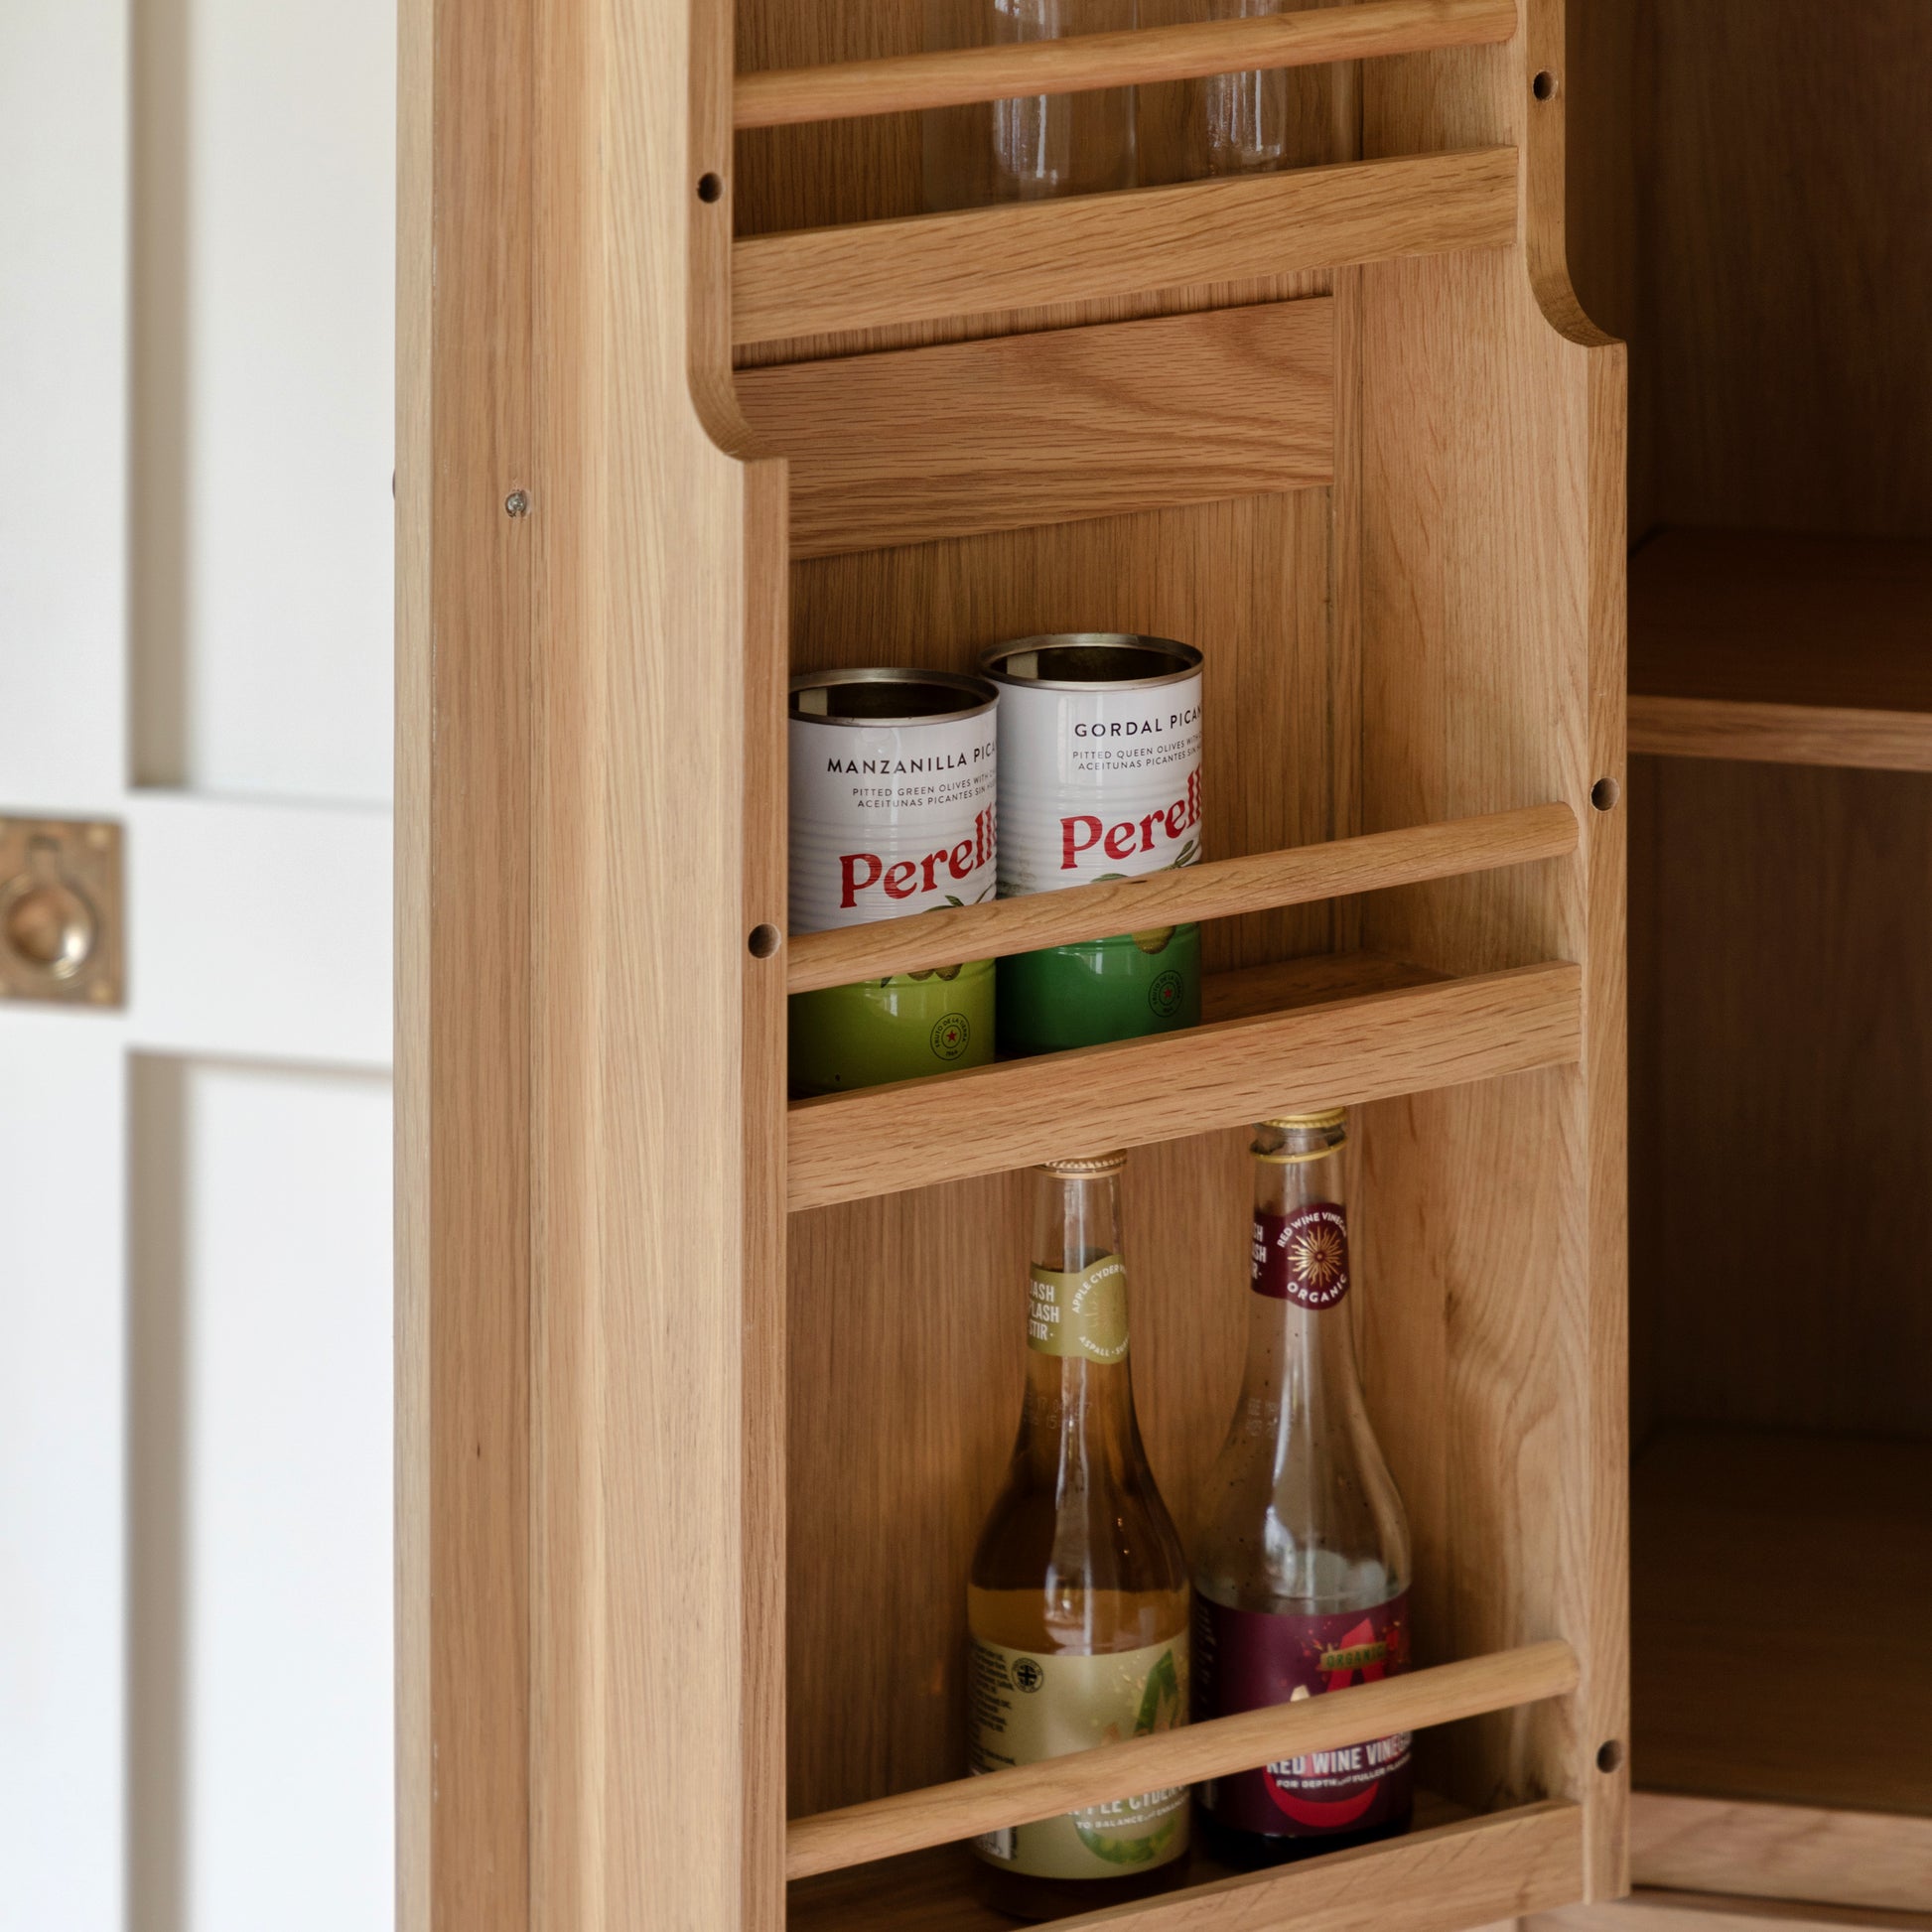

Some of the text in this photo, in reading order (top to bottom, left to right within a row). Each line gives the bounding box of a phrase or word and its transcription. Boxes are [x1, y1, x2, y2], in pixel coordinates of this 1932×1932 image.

[1074, 719, 1163, 738] GORDAL
[1072, 751, 1112, 759] PITTED
[1116, 748, 1153, 759] QUEEN
[1157, 739, 1184, 755] OLIVES
[826, 752, 968, 775] MANZANILLA
[1077, 759, 1142, 770] ACEITUNAS
[1146, 751, 1185, 766] PICANTES
[852, 787, 893, 797] PITTED
[897, 785, 934, 796] GREEN
[938, 778, 971, 793] OLIVES
[857, 798, 923, 808] ACEITUNAS
[927, 790, 973, 805] PICANTES
[839, 800, 997, 909] Perell
[1277, 1227, 1294, 1248] RED
[1291, 1212, 1320, 1230] WINE
[1071, 1281, 1092, 1314] APPLE
[1090, 1264, 1121, 1285] CYDER
[1287, 1273, 1347, 1304] ORGANIC
[1078, 1334, 1111, 1357] ASPALL
[1311, 1746, 1362, 1774] WINE
[1276, 1779, 1299, 1788] FOR
[1301, 1777, 1336, 1789] DEPTH
[1075, 1821, 1092, 1830] TO
